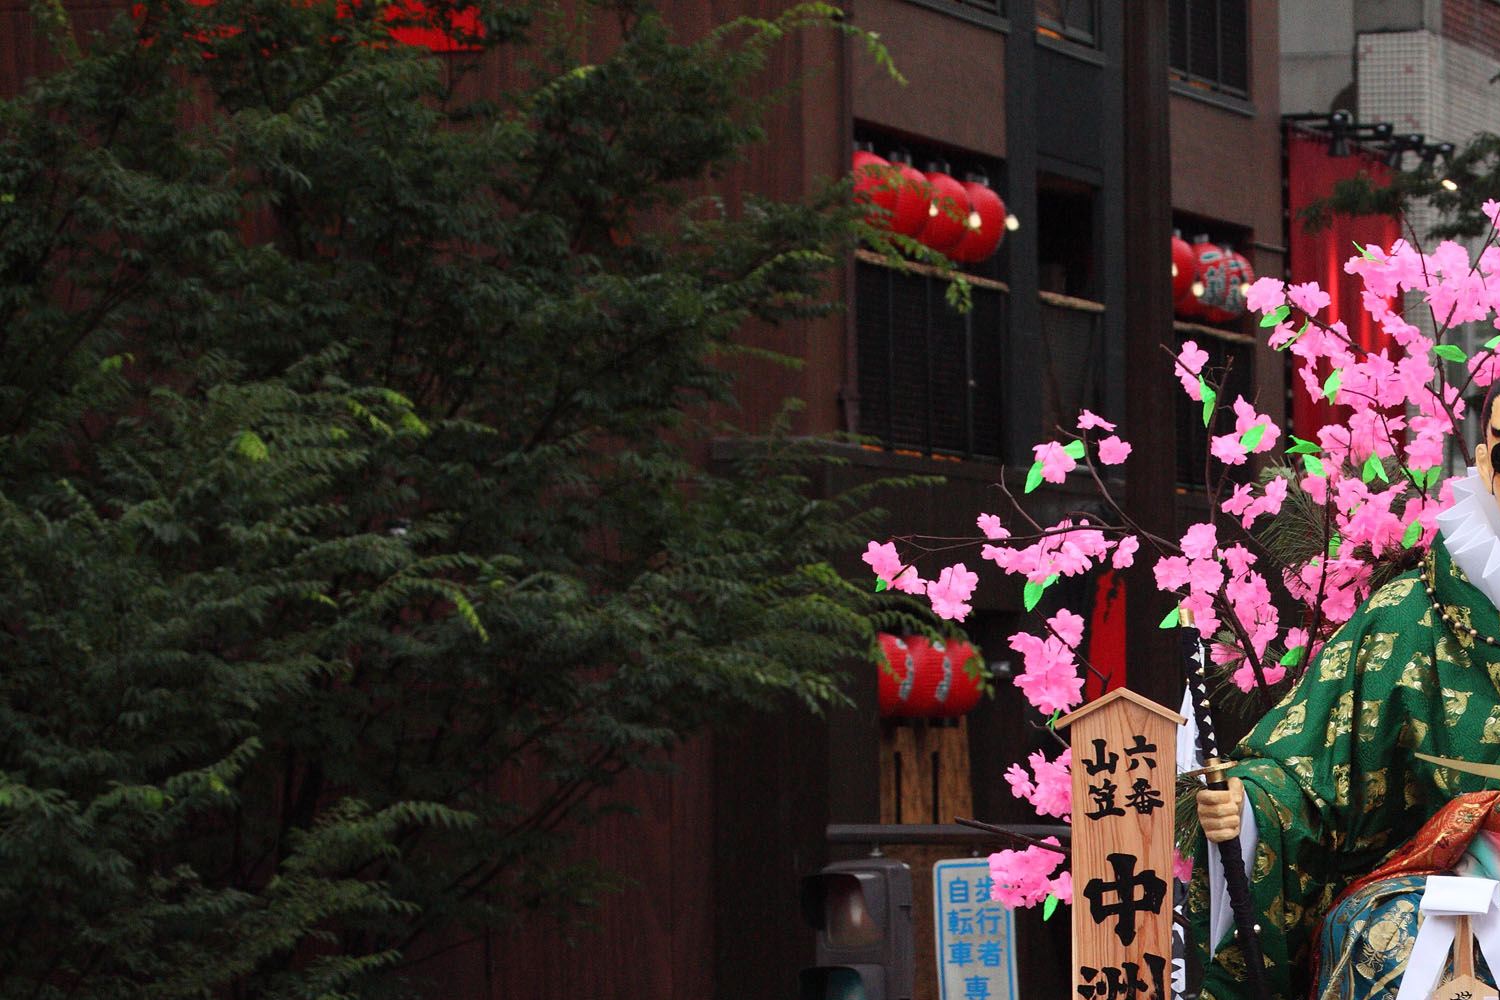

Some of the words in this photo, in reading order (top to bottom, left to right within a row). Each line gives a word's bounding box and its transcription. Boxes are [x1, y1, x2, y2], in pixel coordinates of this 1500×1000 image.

[1082, 738, 1126, 821] 山笠
[1124, 735, 1165, 815] 六番
[947, 875, 973, 967] 自転車
[975, 875, 1003, 968] 歩行者
